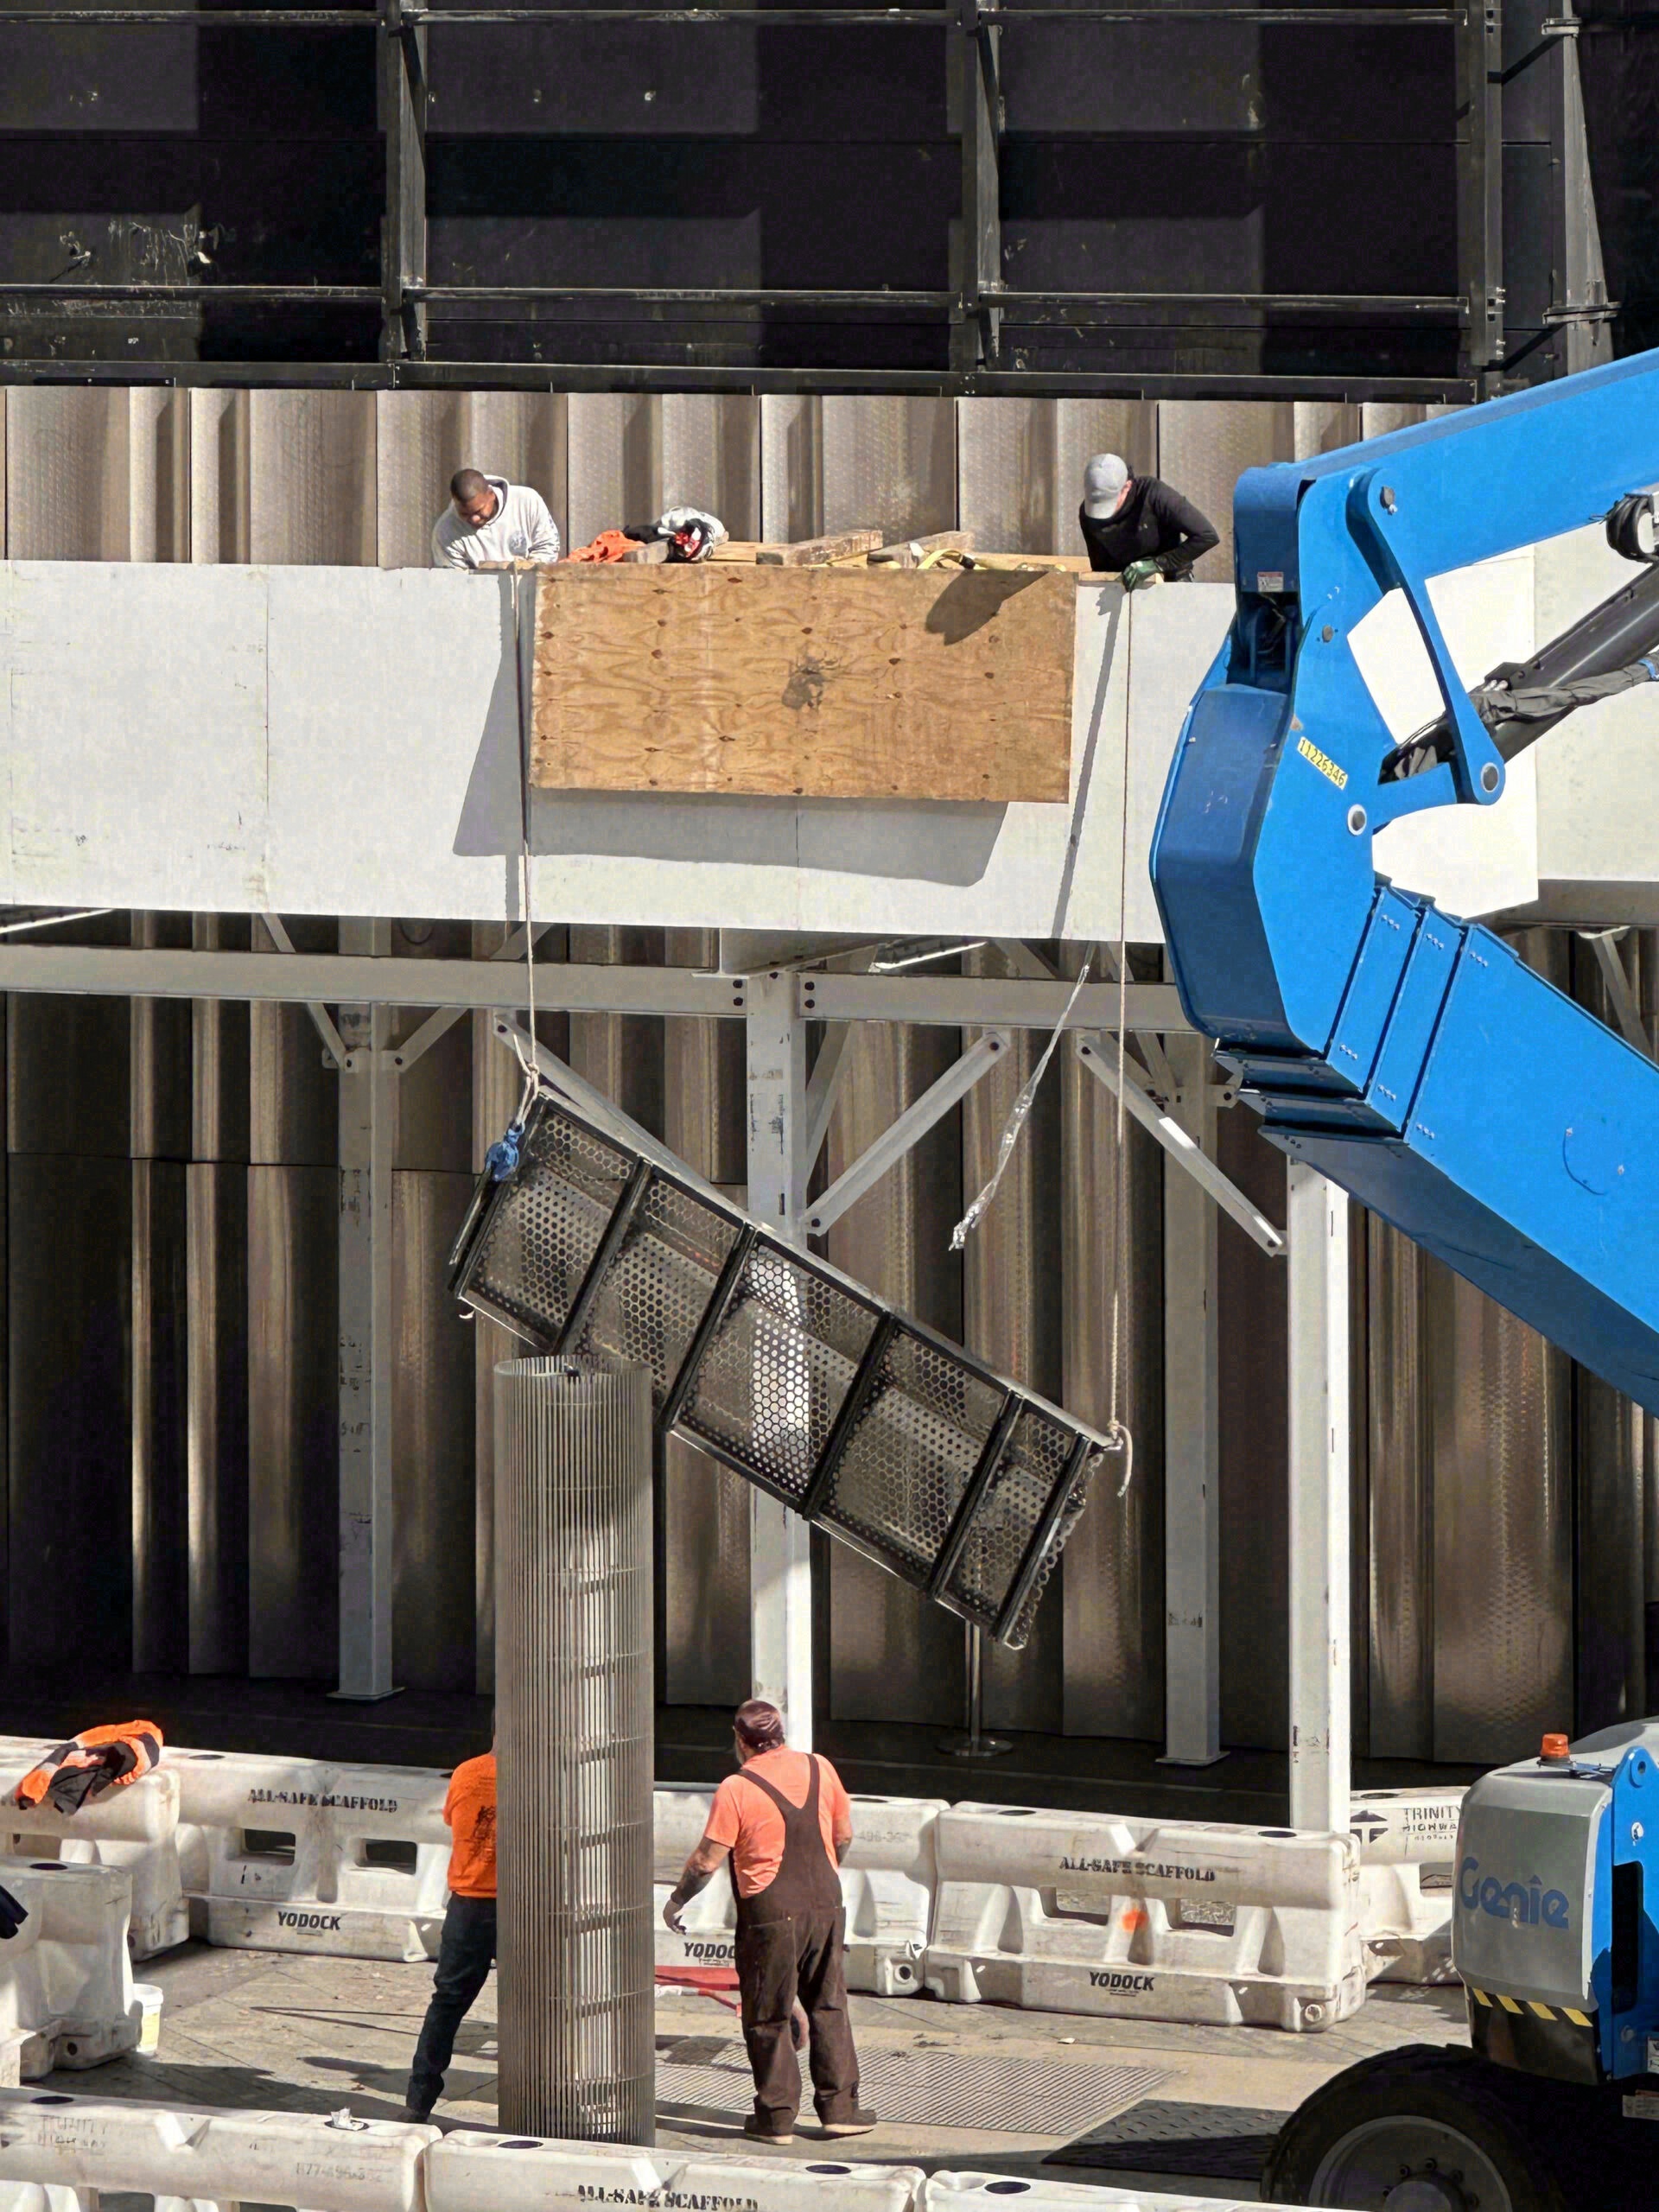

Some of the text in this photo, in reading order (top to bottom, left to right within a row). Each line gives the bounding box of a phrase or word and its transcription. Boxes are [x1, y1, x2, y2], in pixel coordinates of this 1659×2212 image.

[1058, 1856, 1217, 1882] ALL-SAFE SCAFFOLD
[1459, 1856, 1570, 1930] Genie
[277, 1910, 341, 1931] YODOCK
[683, 1942, 736, 1960] YODOC
[1089, 1971, 1155, 1991] YODOCK
